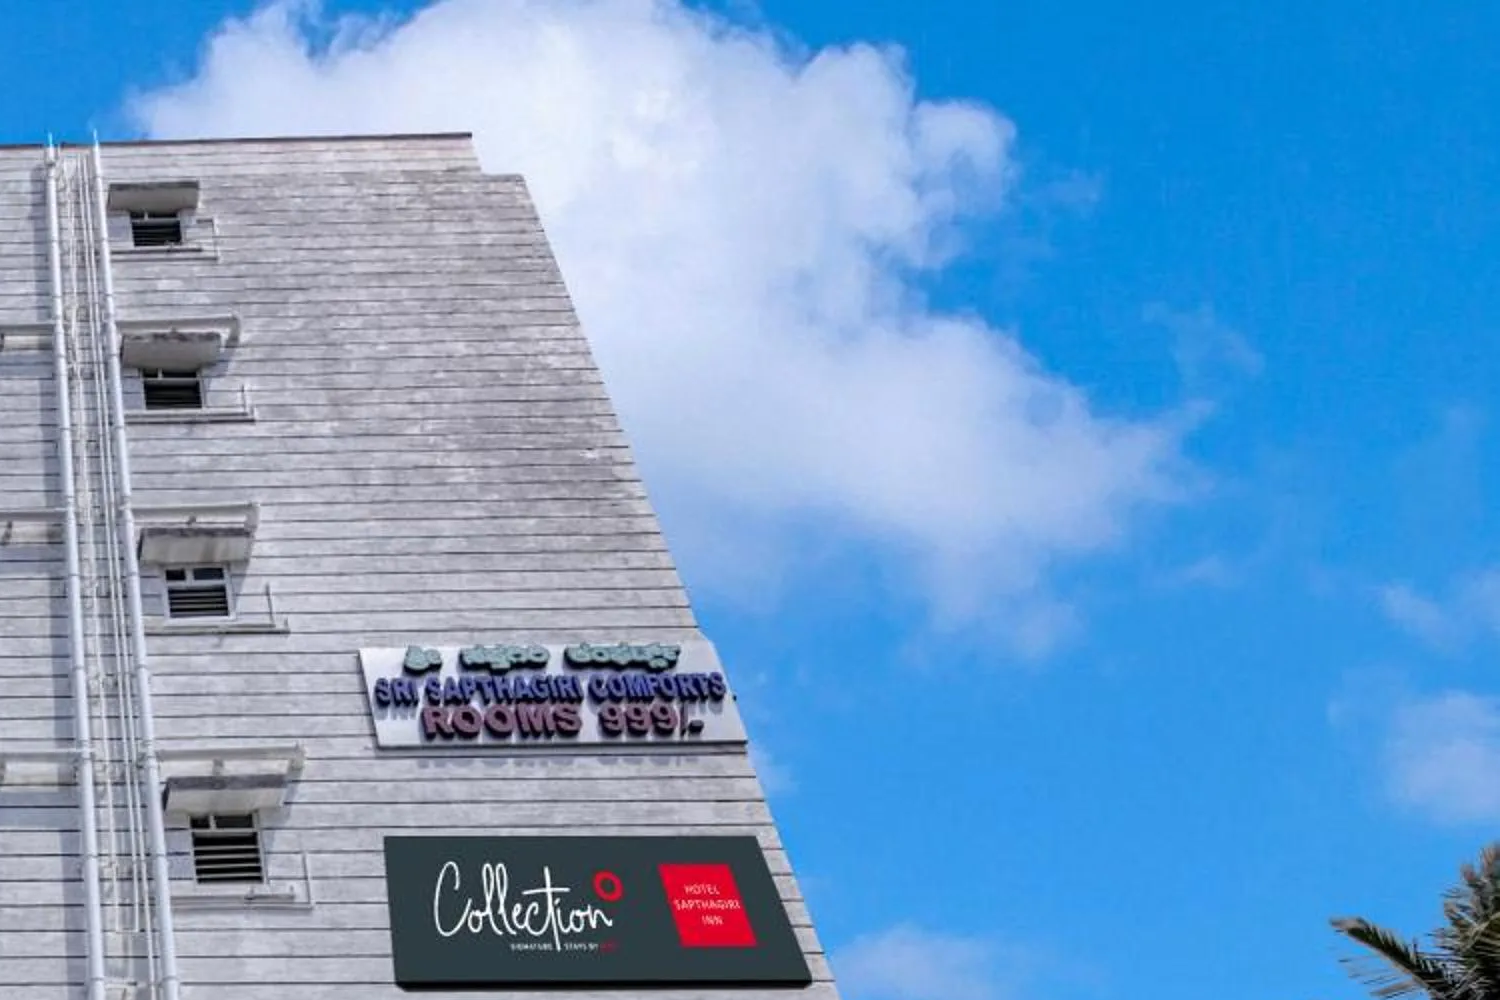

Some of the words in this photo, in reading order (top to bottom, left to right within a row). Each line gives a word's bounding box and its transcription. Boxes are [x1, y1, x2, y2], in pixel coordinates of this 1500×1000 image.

[374, 678, 419, 707] SRI
[424, 675, 583, 705] SAPTHAGIRI
[588, 672, 727, 701] COMFORTS
[420, 703, 583, 740] ROOMS
[434, 861, 613, 951] Collection
[684, 883, 721, 896] HOTEL
